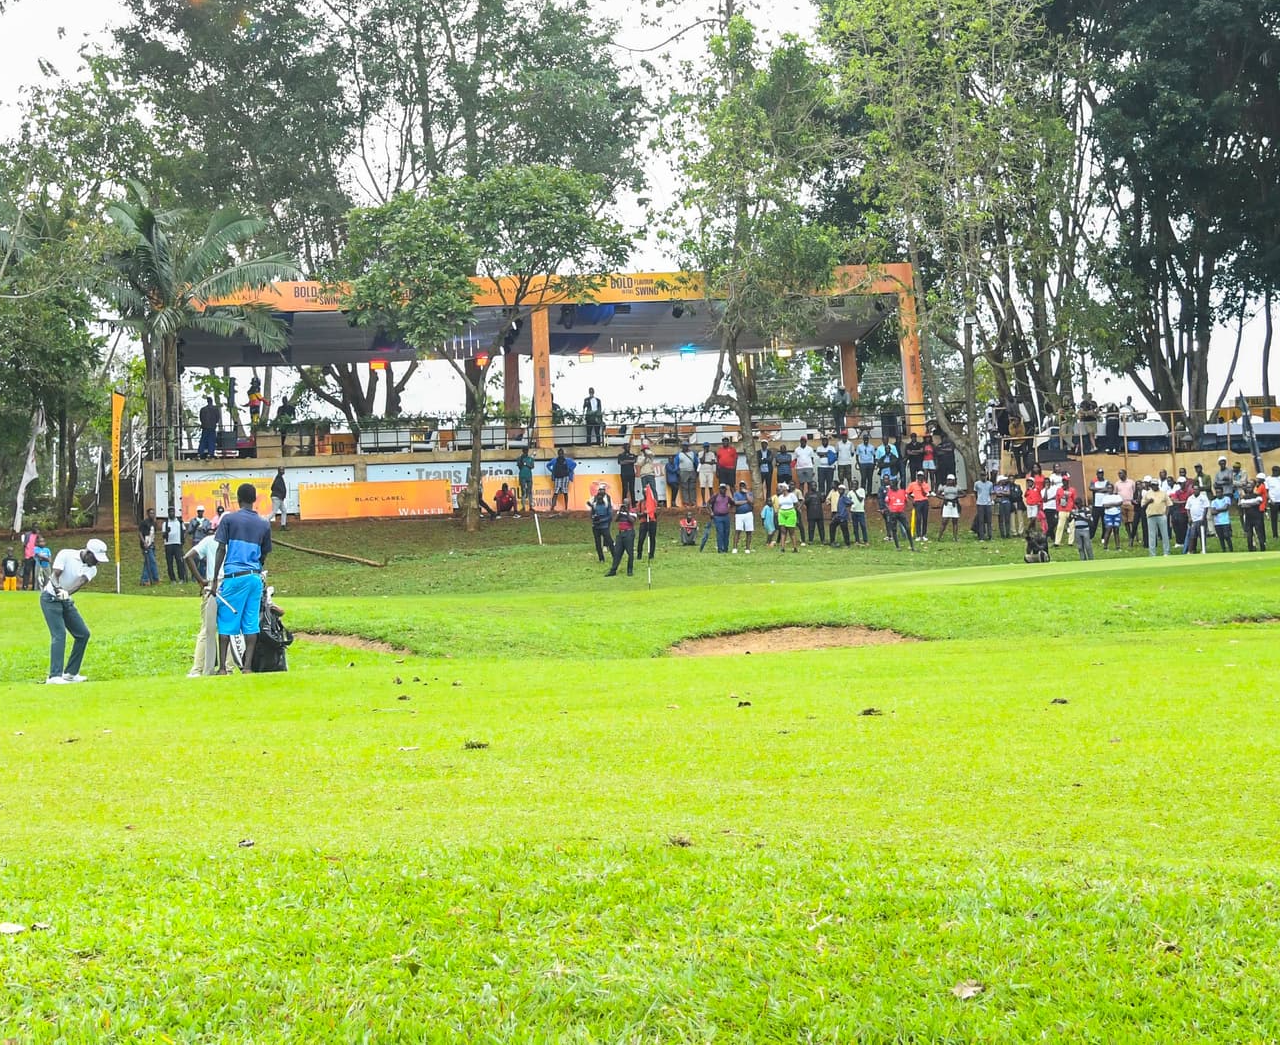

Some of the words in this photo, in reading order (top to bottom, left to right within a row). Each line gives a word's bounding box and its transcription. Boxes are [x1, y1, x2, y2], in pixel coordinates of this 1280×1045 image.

[611, 277, 633, 289] BOLD
[294, 286, 318, 298] BOLD
[636, 287, 659, 296] SWING
[320, 297, 340, 306] SWIN
[398, 507, 444, 516] WALKER
